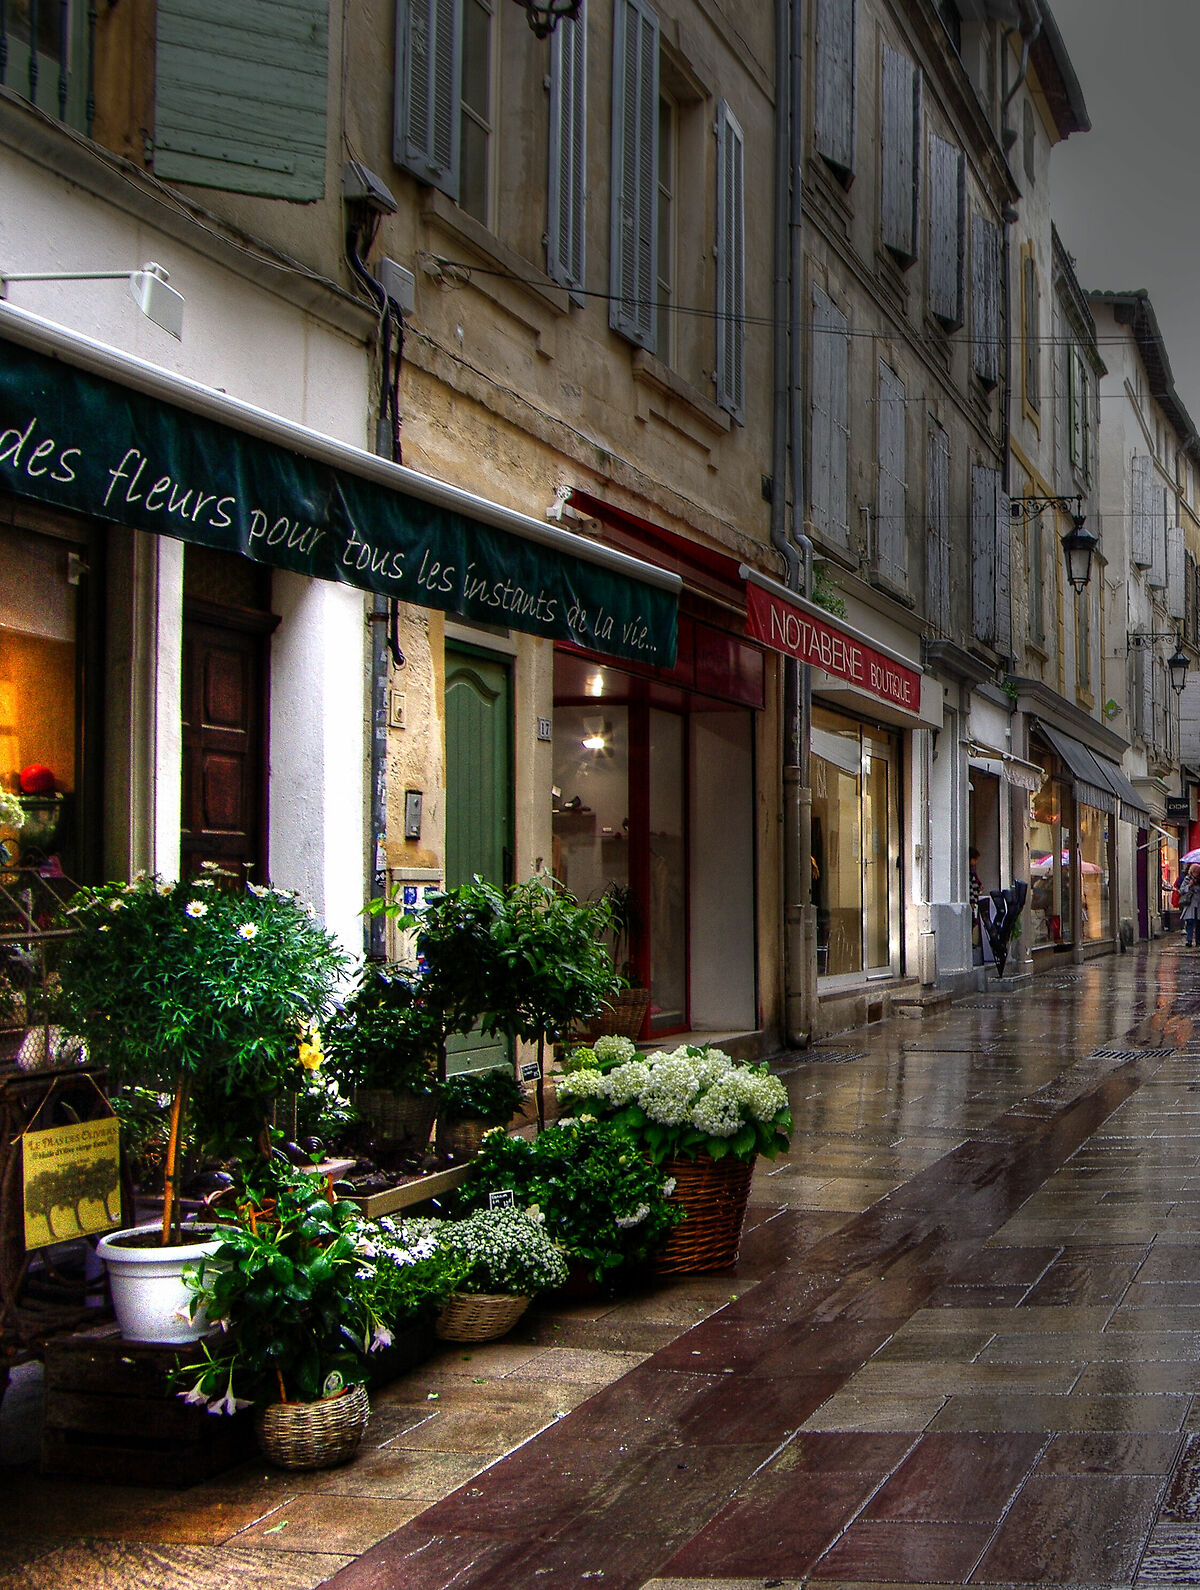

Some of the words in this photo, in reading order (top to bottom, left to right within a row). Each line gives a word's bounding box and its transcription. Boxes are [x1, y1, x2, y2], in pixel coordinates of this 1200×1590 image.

[0, 417, 82, 482] des
[103, 448, 236, 527] fleurs
[248, 509, 327, 555] pour
[342, 528, 405, 579] tous
[417, 549, 455, 592] les
[463, 562, 558, 622] instants
[566, 598, 588, 633] de
[594, 607, 614, 640] la
[770, 604, 863, 681] NOTABENE
[870, 662, 911, 704] BOUTIQUE
[541, 721, 550, 736] 17
